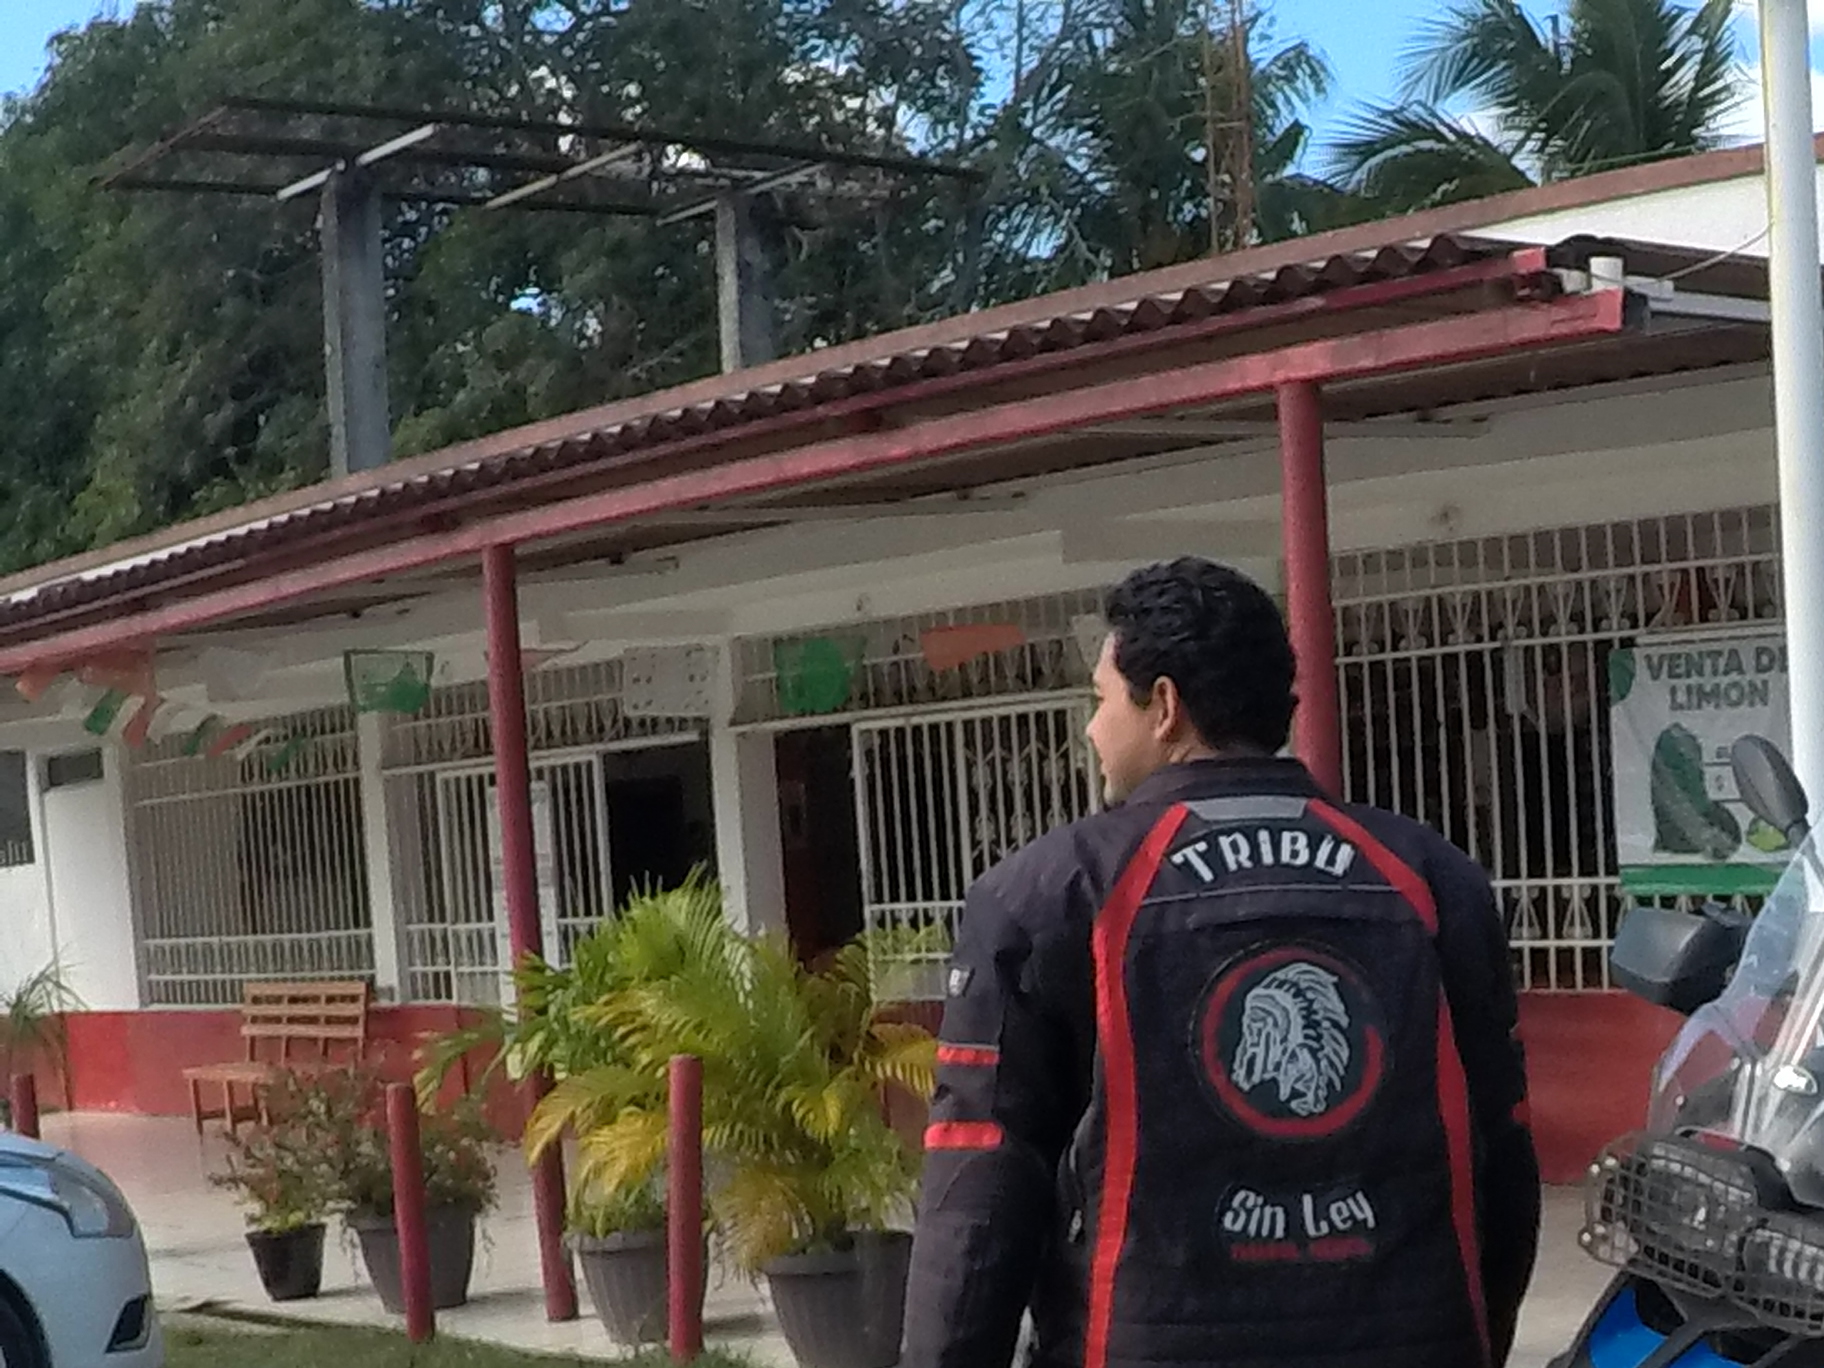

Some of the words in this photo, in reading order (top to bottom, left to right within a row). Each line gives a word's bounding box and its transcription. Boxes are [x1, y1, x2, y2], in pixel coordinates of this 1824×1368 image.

[1644, 648, 1745, 681] VENTA
[1669, 679, 1769, 711] LIMON
[1170, 828, 1355, 883] TRIBU
[1223, 1189, 1286, 1238] Sin
[1302, 1190, 1376, 1238] Ley
